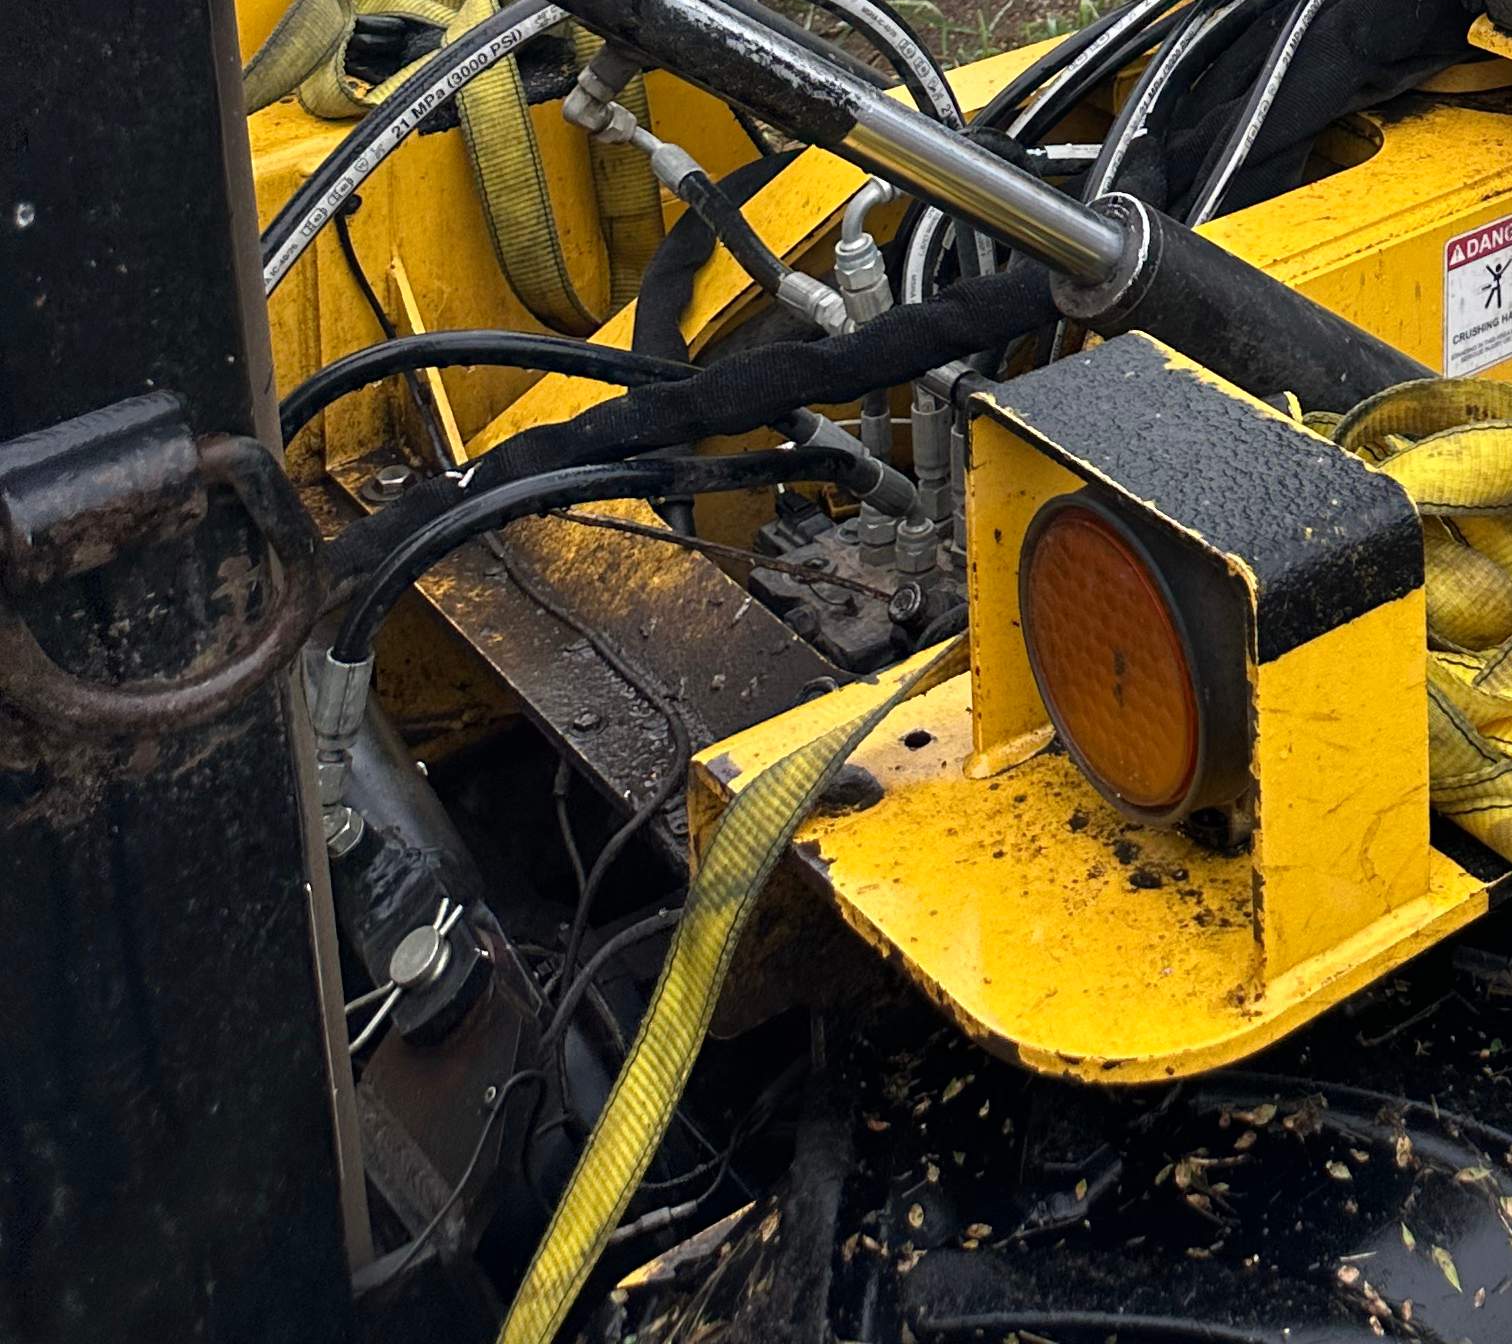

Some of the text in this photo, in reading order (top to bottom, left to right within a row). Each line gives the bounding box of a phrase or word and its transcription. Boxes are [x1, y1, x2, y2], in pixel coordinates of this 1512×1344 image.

[391, 28, 523, 139] 21 MPa (3000 PSI)
[1452, 317, 1500, 345] CRUSHING
